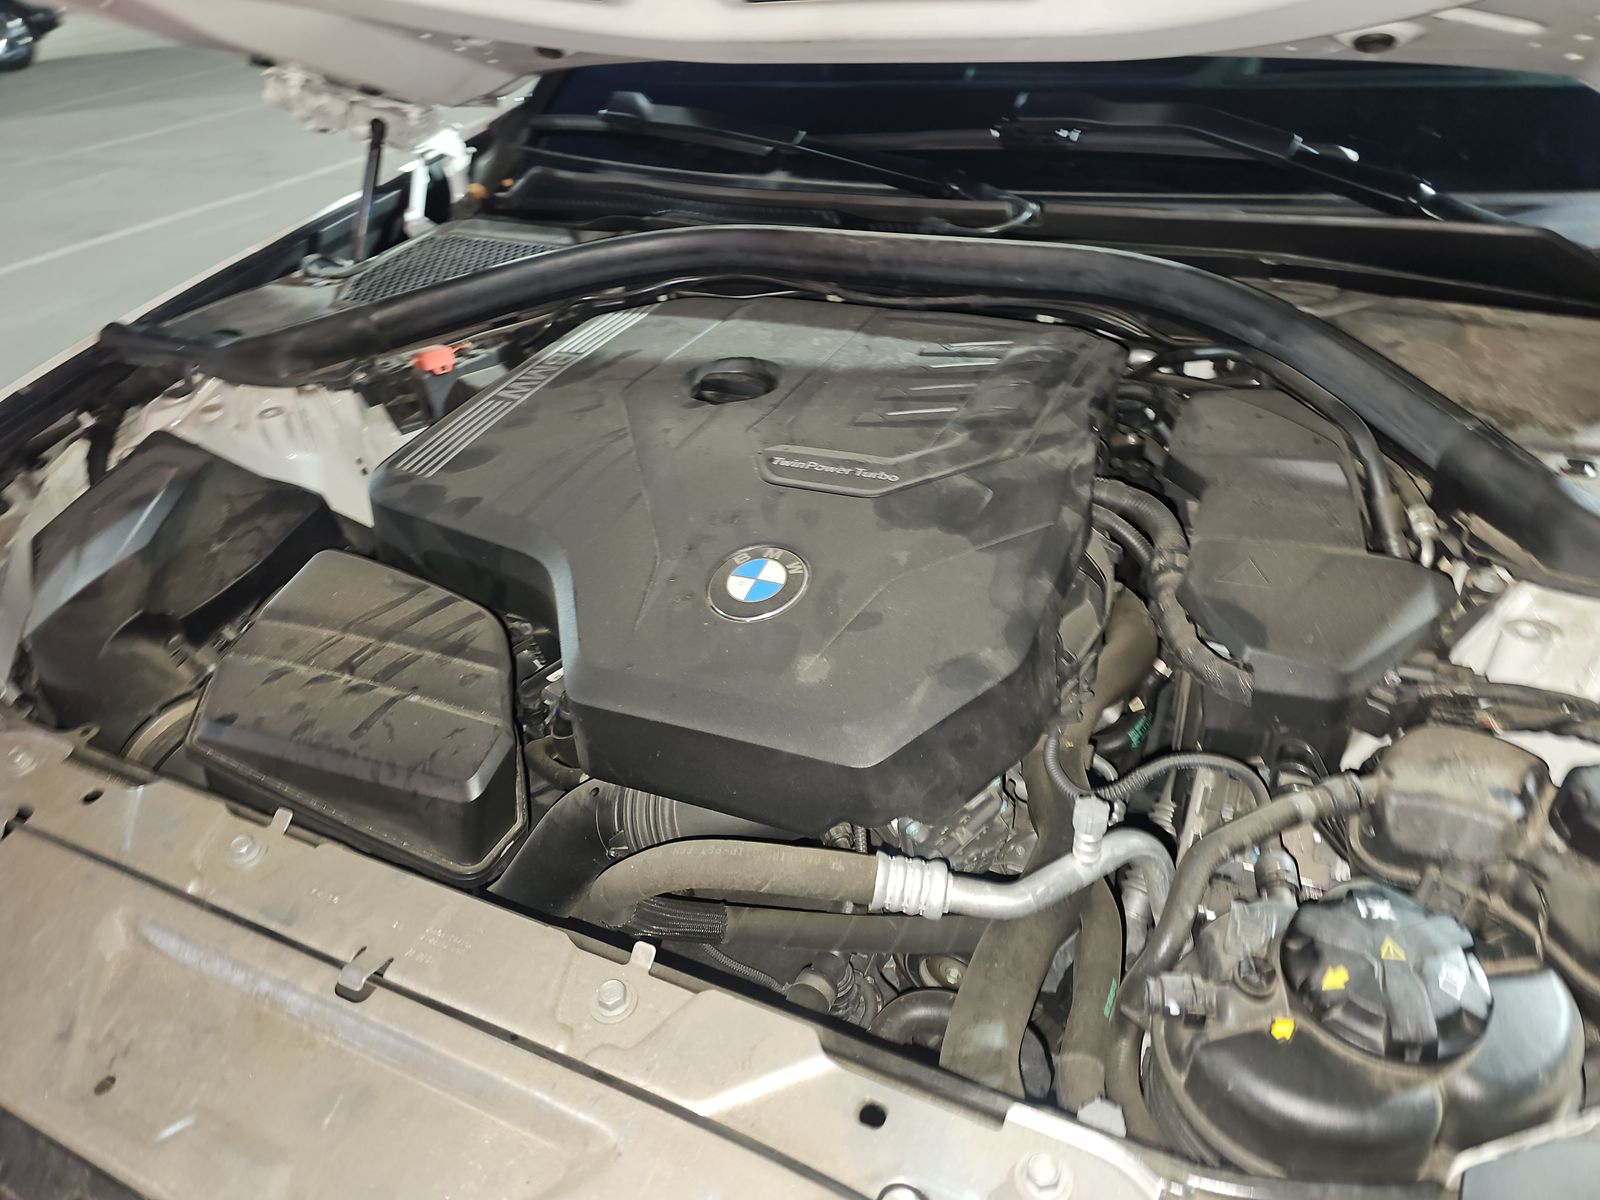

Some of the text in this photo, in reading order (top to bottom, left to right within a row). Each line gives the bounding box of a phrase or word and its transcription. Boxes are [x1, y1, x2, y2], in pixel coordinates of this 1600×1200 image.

[496, 351, 580, 400] BMW
[771, 456, 900, 482] TwinPower Turbo
[732, 549, 804, 575] BMW
